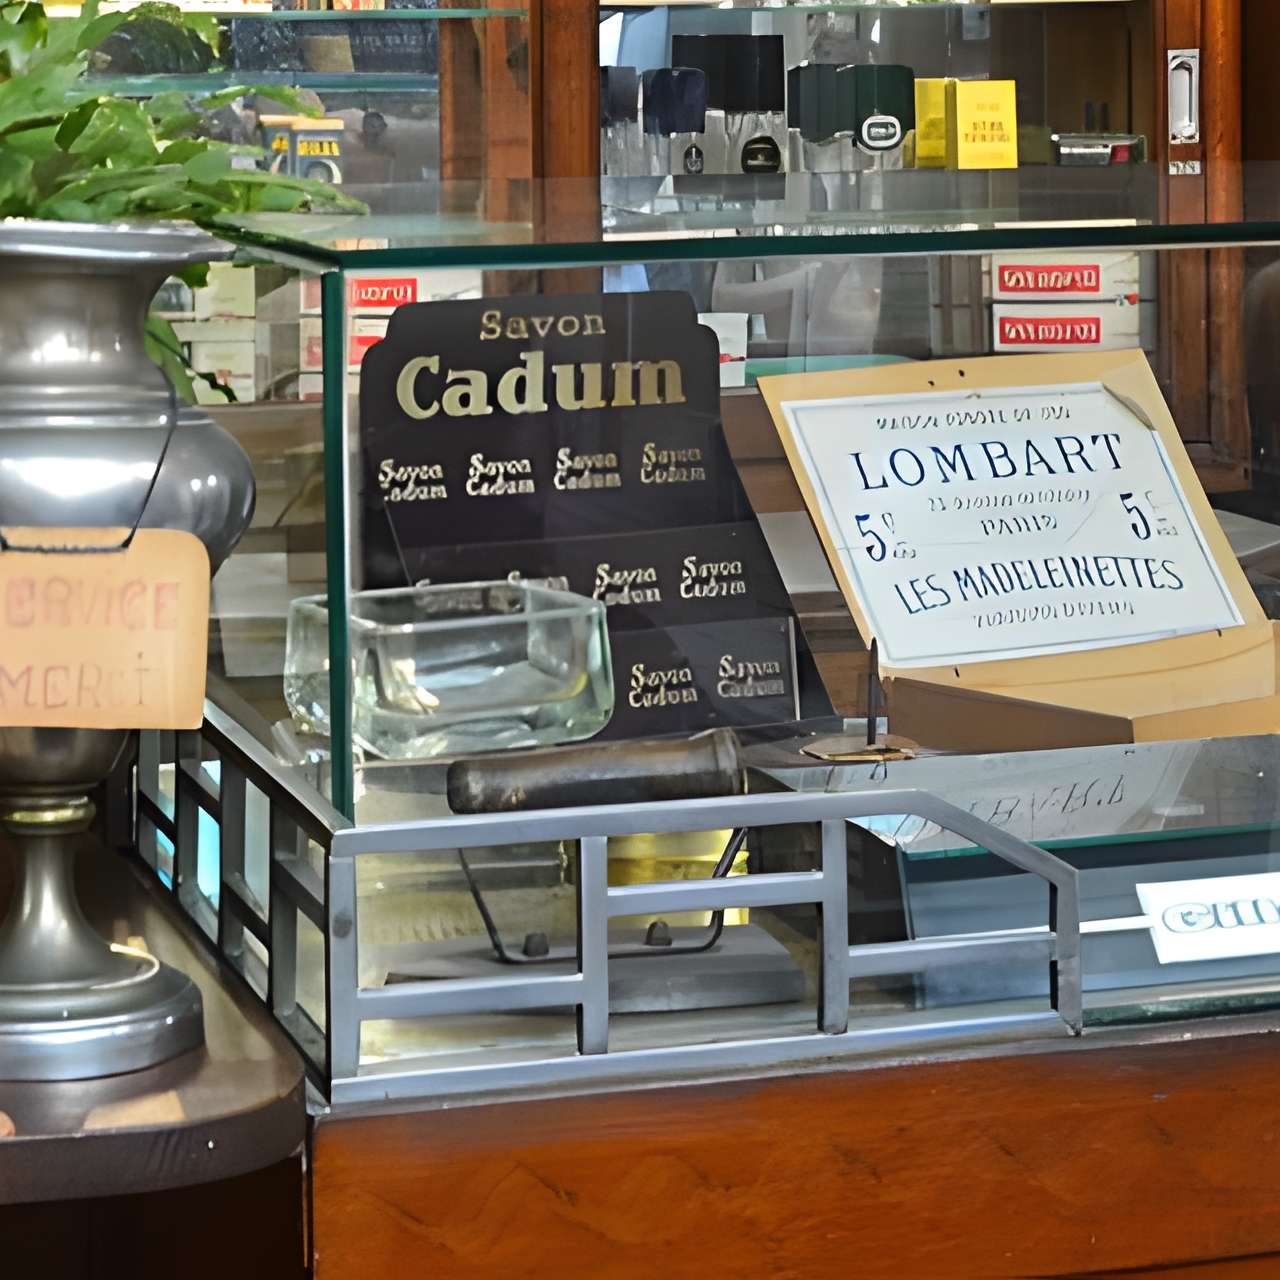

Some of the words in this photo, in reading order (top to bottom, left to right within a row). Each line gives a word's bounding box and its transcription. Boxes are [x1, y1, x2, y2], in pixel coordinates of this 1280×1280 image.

[479, 310, 606, 340] Savon
[396, 350, 686, 419] Cadum
[849, 433, 1124, 490] LOMBART
[894, 574, 951, 615] LES
